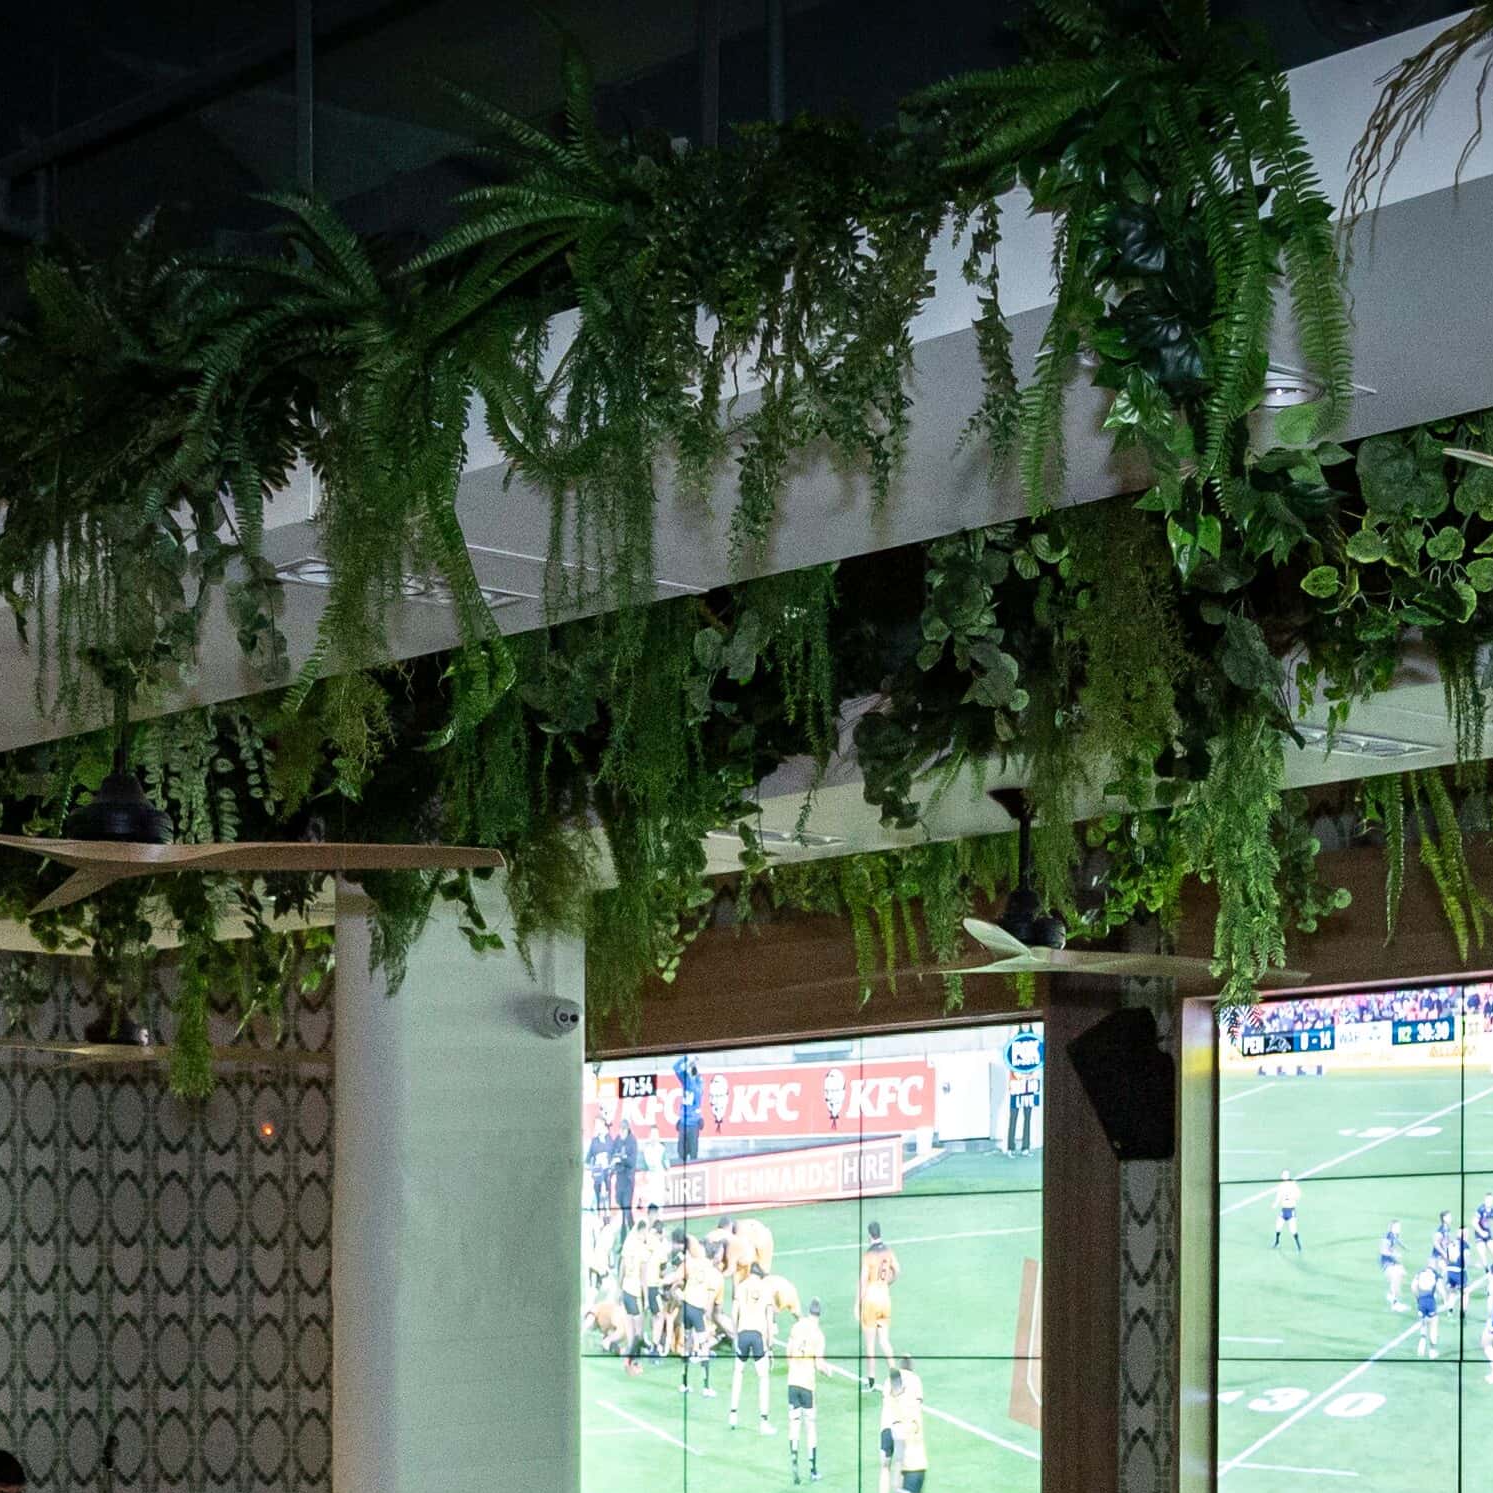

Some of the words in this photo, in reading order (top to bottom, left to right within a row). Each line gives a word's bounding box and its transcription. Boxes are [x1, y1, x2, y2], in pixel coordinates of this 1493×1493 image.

[729, 1083, 801, 1123] KFC
[846, 1076, 924, 1118] KFC
[842, 1151, 890, 1185] HIRE
